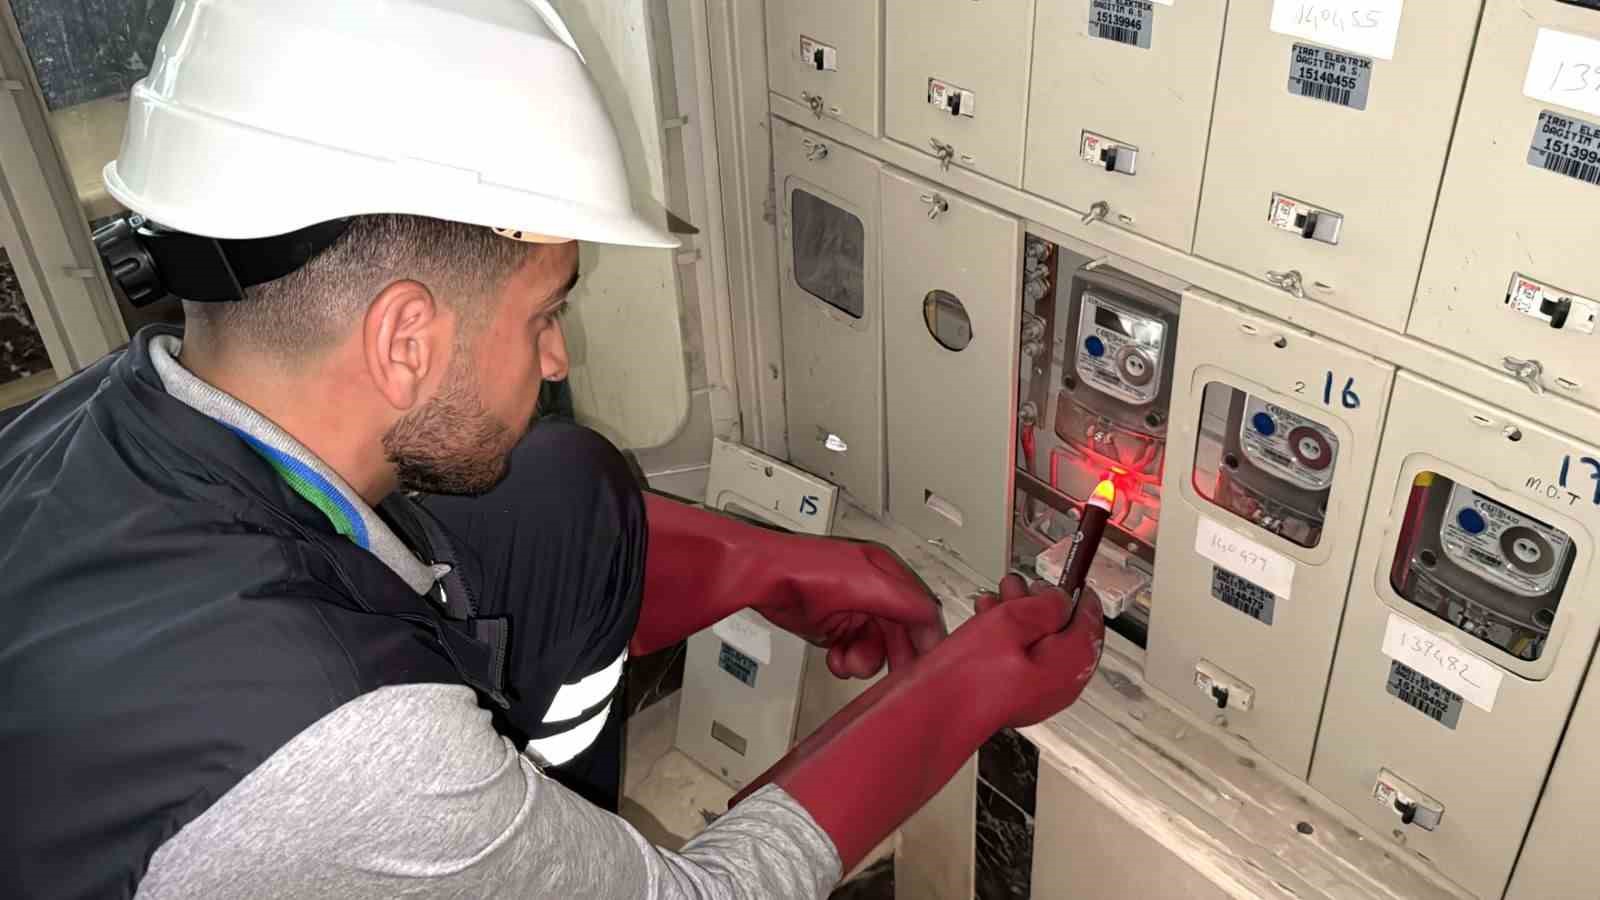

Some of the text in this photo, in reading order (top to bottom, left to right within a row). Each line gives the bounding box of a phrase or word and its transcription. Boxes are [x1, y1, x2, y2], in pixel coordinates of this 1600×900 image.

[1096, 11, 1142, 30] 15139946
[1292, 44, 1372, 69] FIRAT ELEKTRIK
[1299, 67, 1357, 89] 15140455
[1539, 113, 1574, 129] FIRAT
[1295, 381, 1305, 393] 2
[1323, 370, 1360, 409] 16
[800, 495, 819, 515] 15
